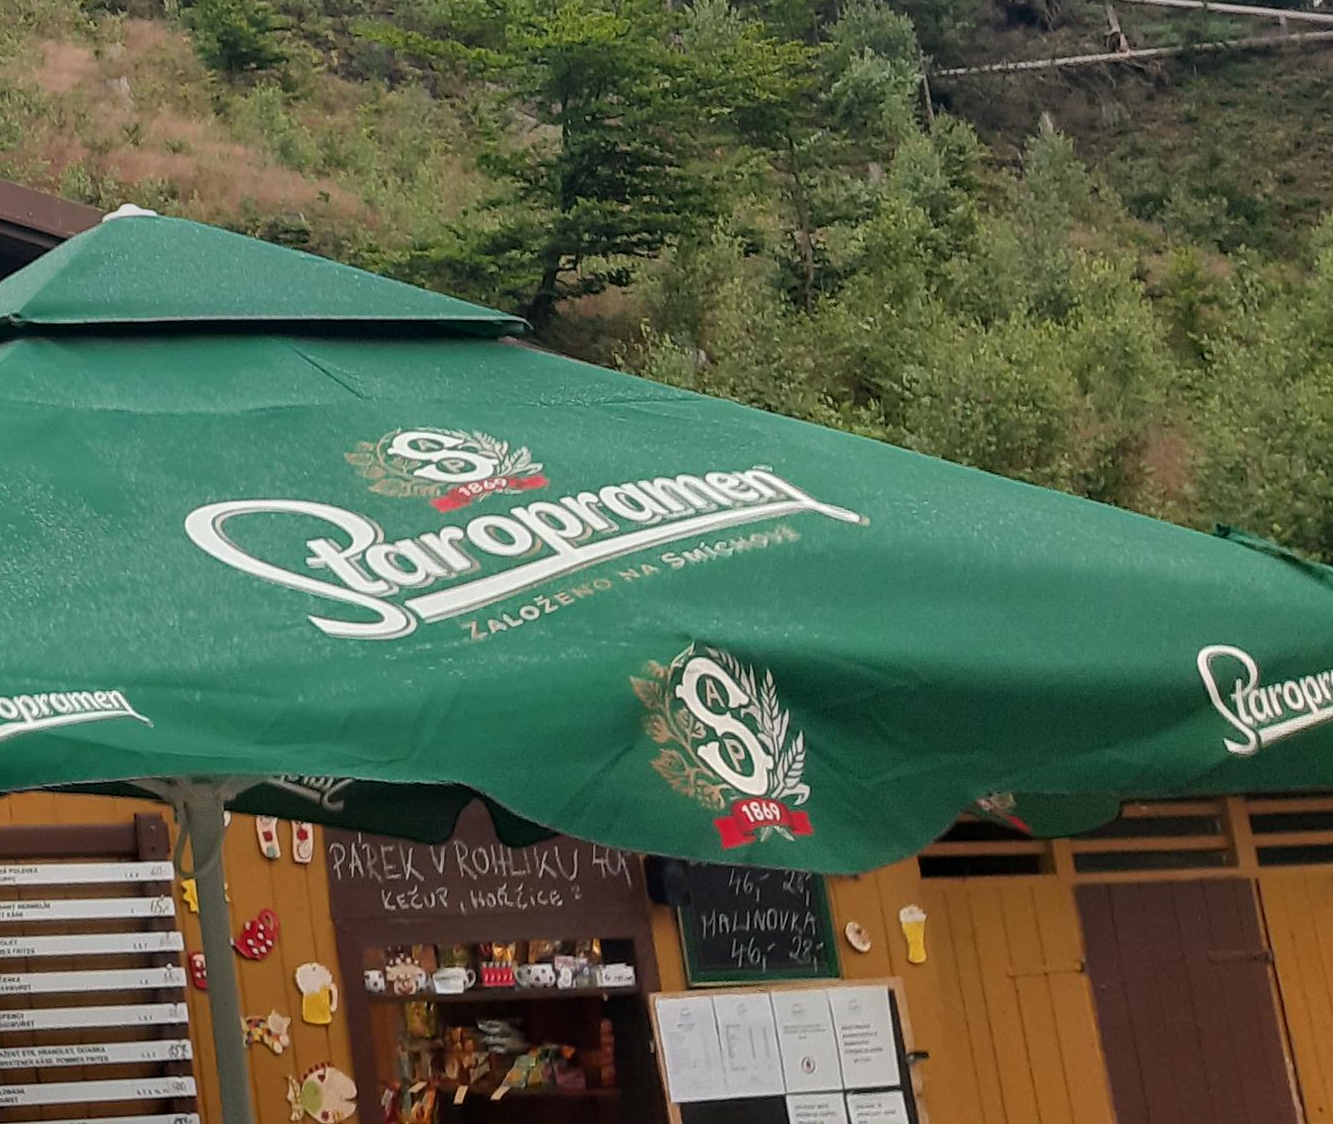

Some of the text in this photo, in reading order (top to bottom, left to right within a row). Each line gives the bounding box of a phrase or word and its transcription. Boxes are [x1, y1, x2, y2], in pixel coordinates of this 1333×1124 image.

[458, 477, 509, 497] 1869
[184, 467, 871, 640] Staropramen
[459, 575, 613, 642] ZALOŽENO
[619, 561, 660, 582] NA
[1196, 644, 1333, 756] Staropr
[741, 801, 782, 823] 1869
[431, 845, 446, 875] V
[700, 906, 817, 940] MALINOVKA
